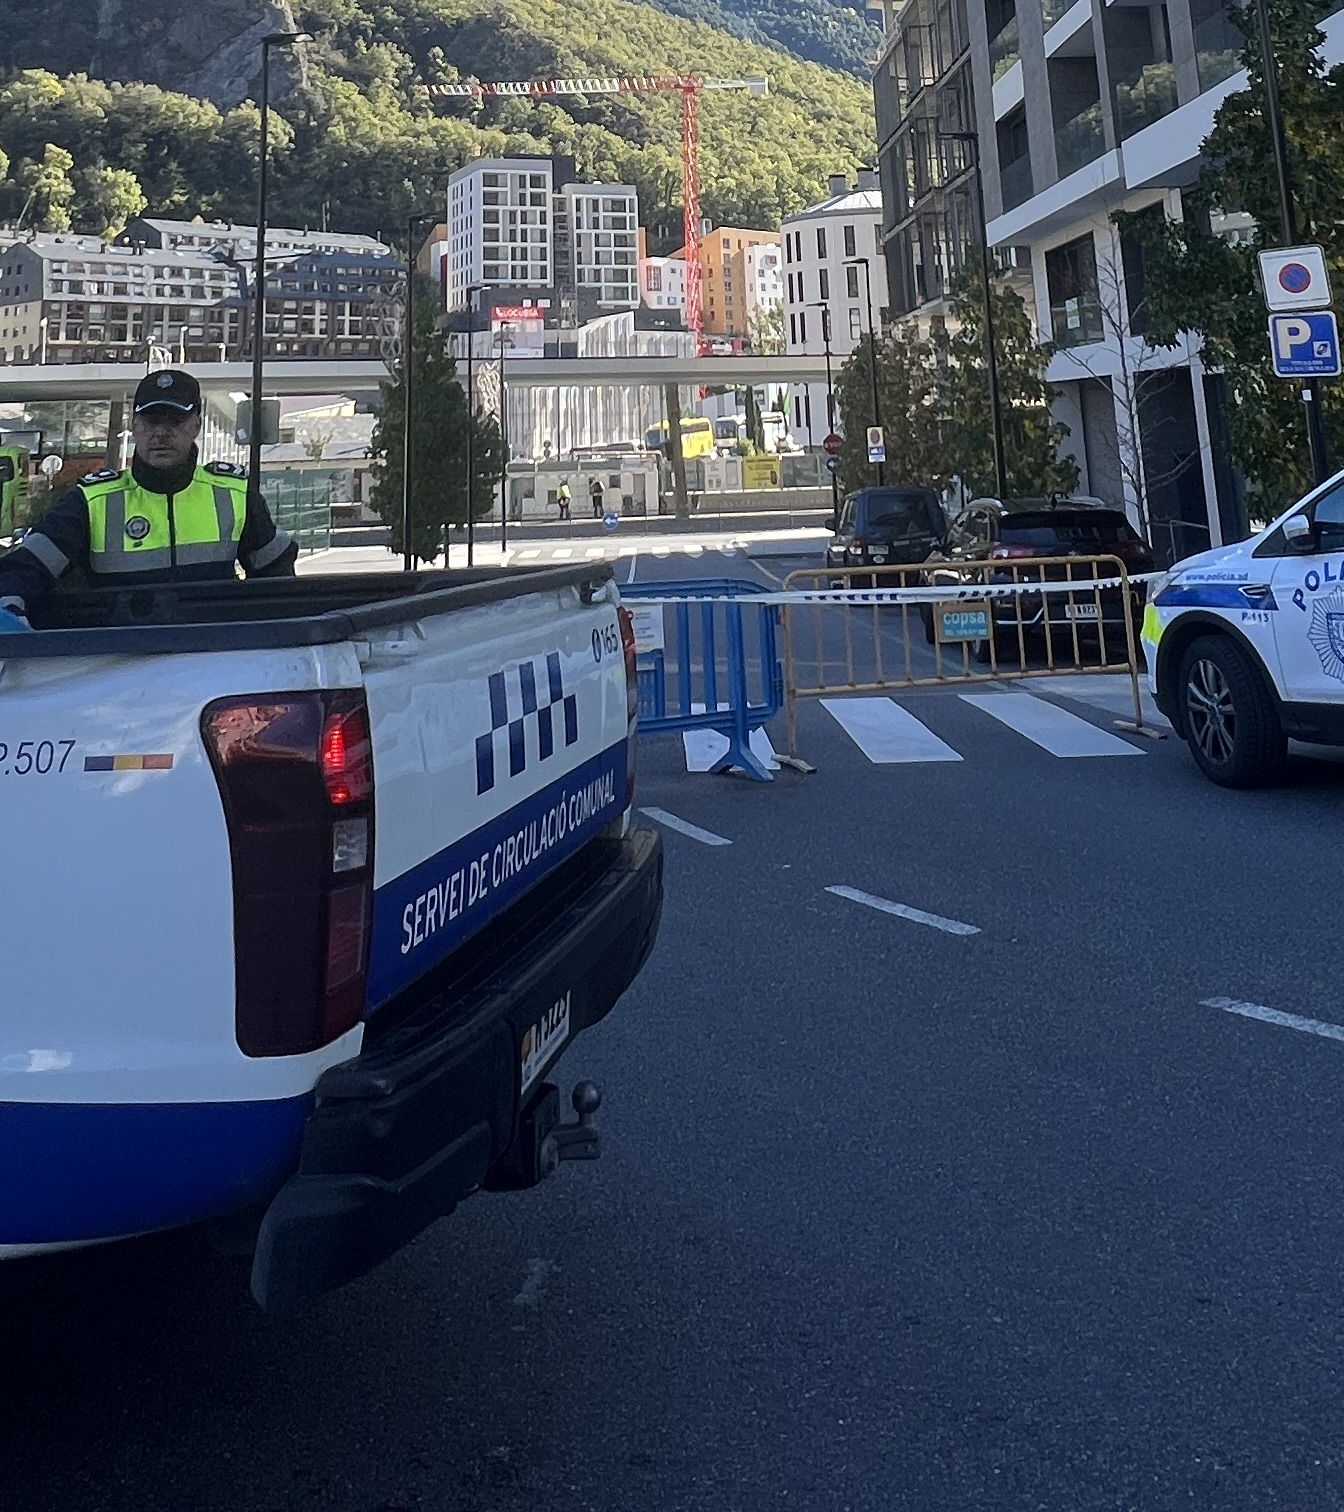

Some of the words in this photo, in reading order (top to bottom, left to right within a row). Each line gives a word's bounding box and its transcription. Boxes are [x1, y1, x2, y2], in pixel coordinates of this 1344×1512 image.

[1276, 318, 1312, 359] P
[943, 611, 986, 629] copsa
[401, 867, 465, 954] SERVEI
[467, 852, 490, 907] DE
[492, 789, 567, 888] CIRCULACIÓ
[568, 767, 615, 832] COMUNAL
